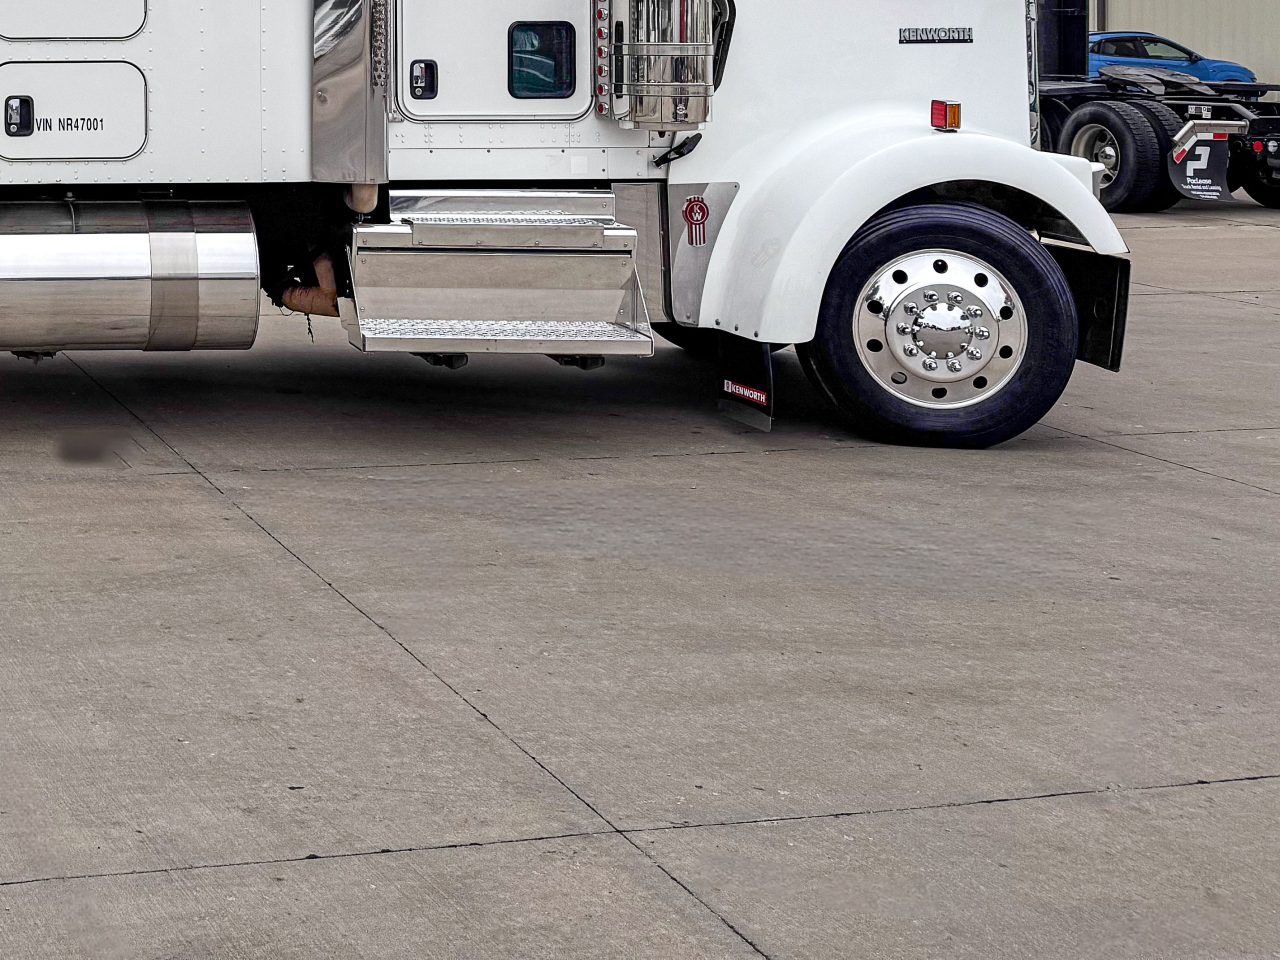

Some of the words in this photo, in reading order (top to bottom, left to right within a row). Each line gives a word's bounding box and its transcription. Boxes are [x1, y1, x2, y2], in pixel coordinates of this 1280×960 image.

[898, 27, 974, 41] KENWORTH
[35, 117, 52, 132] VIN
[58, 117, 104, 132] NR47001
[731, 384, 766, 403] KENWORTH
